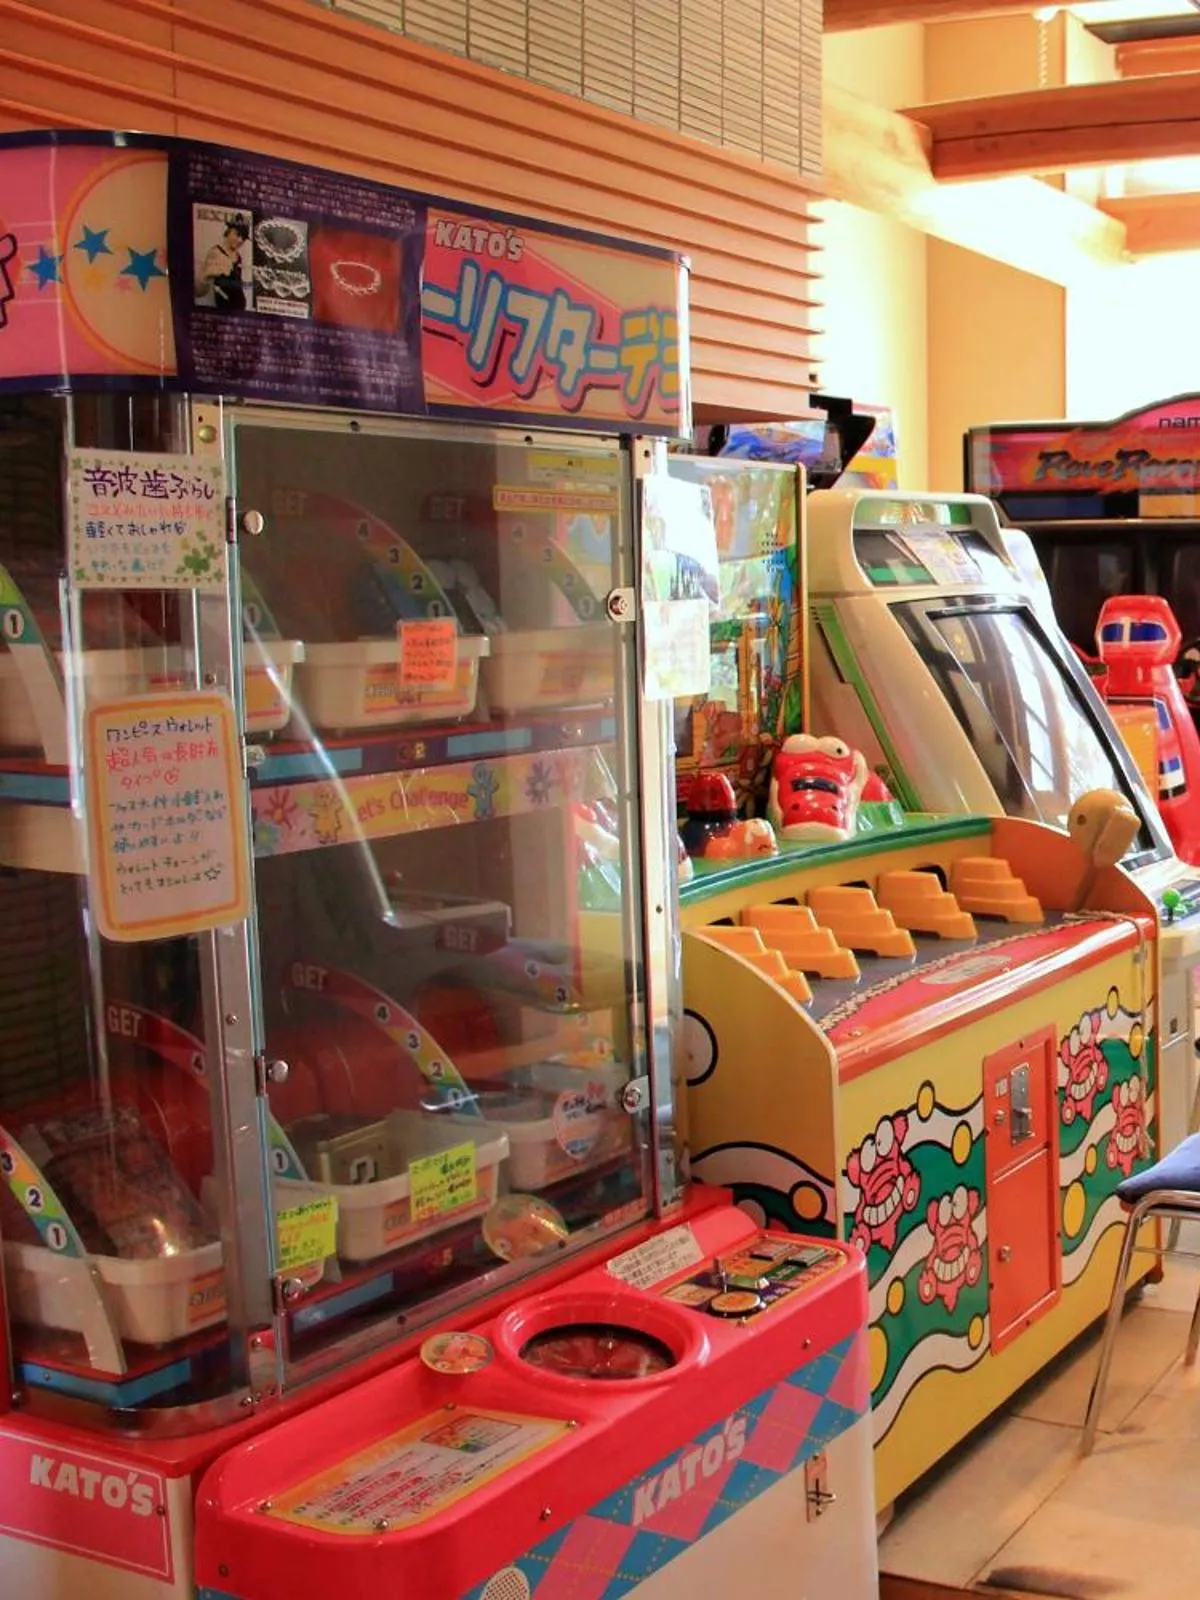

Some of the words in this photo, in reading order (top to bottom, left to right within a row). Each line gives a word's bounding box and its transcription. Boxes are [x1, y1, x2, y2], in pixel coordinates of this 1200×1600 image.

[434, 219, 524, 262] KATO'S
[83, 465, 215, 499] 音波歯ぶらし
[390, 549, 400, 564] 3
[411, 574, 424, 590] 2
[291, 961, 328, 992] GET
[556, 986, 567, 1002] 3
[107, 1004, 143, 1038] GET
[376, 1005, 390, 1021] 4
[408, 1032, 419, 1050] 3
[432, 1061, 443, 1078] 2
[2, 1151, 14, 1172] 3
[28, 1187, 42, 1208] 2
[632, 1415, 747, 1527] KATO'S
[30, 1453, 154, 1516] KATO'S
